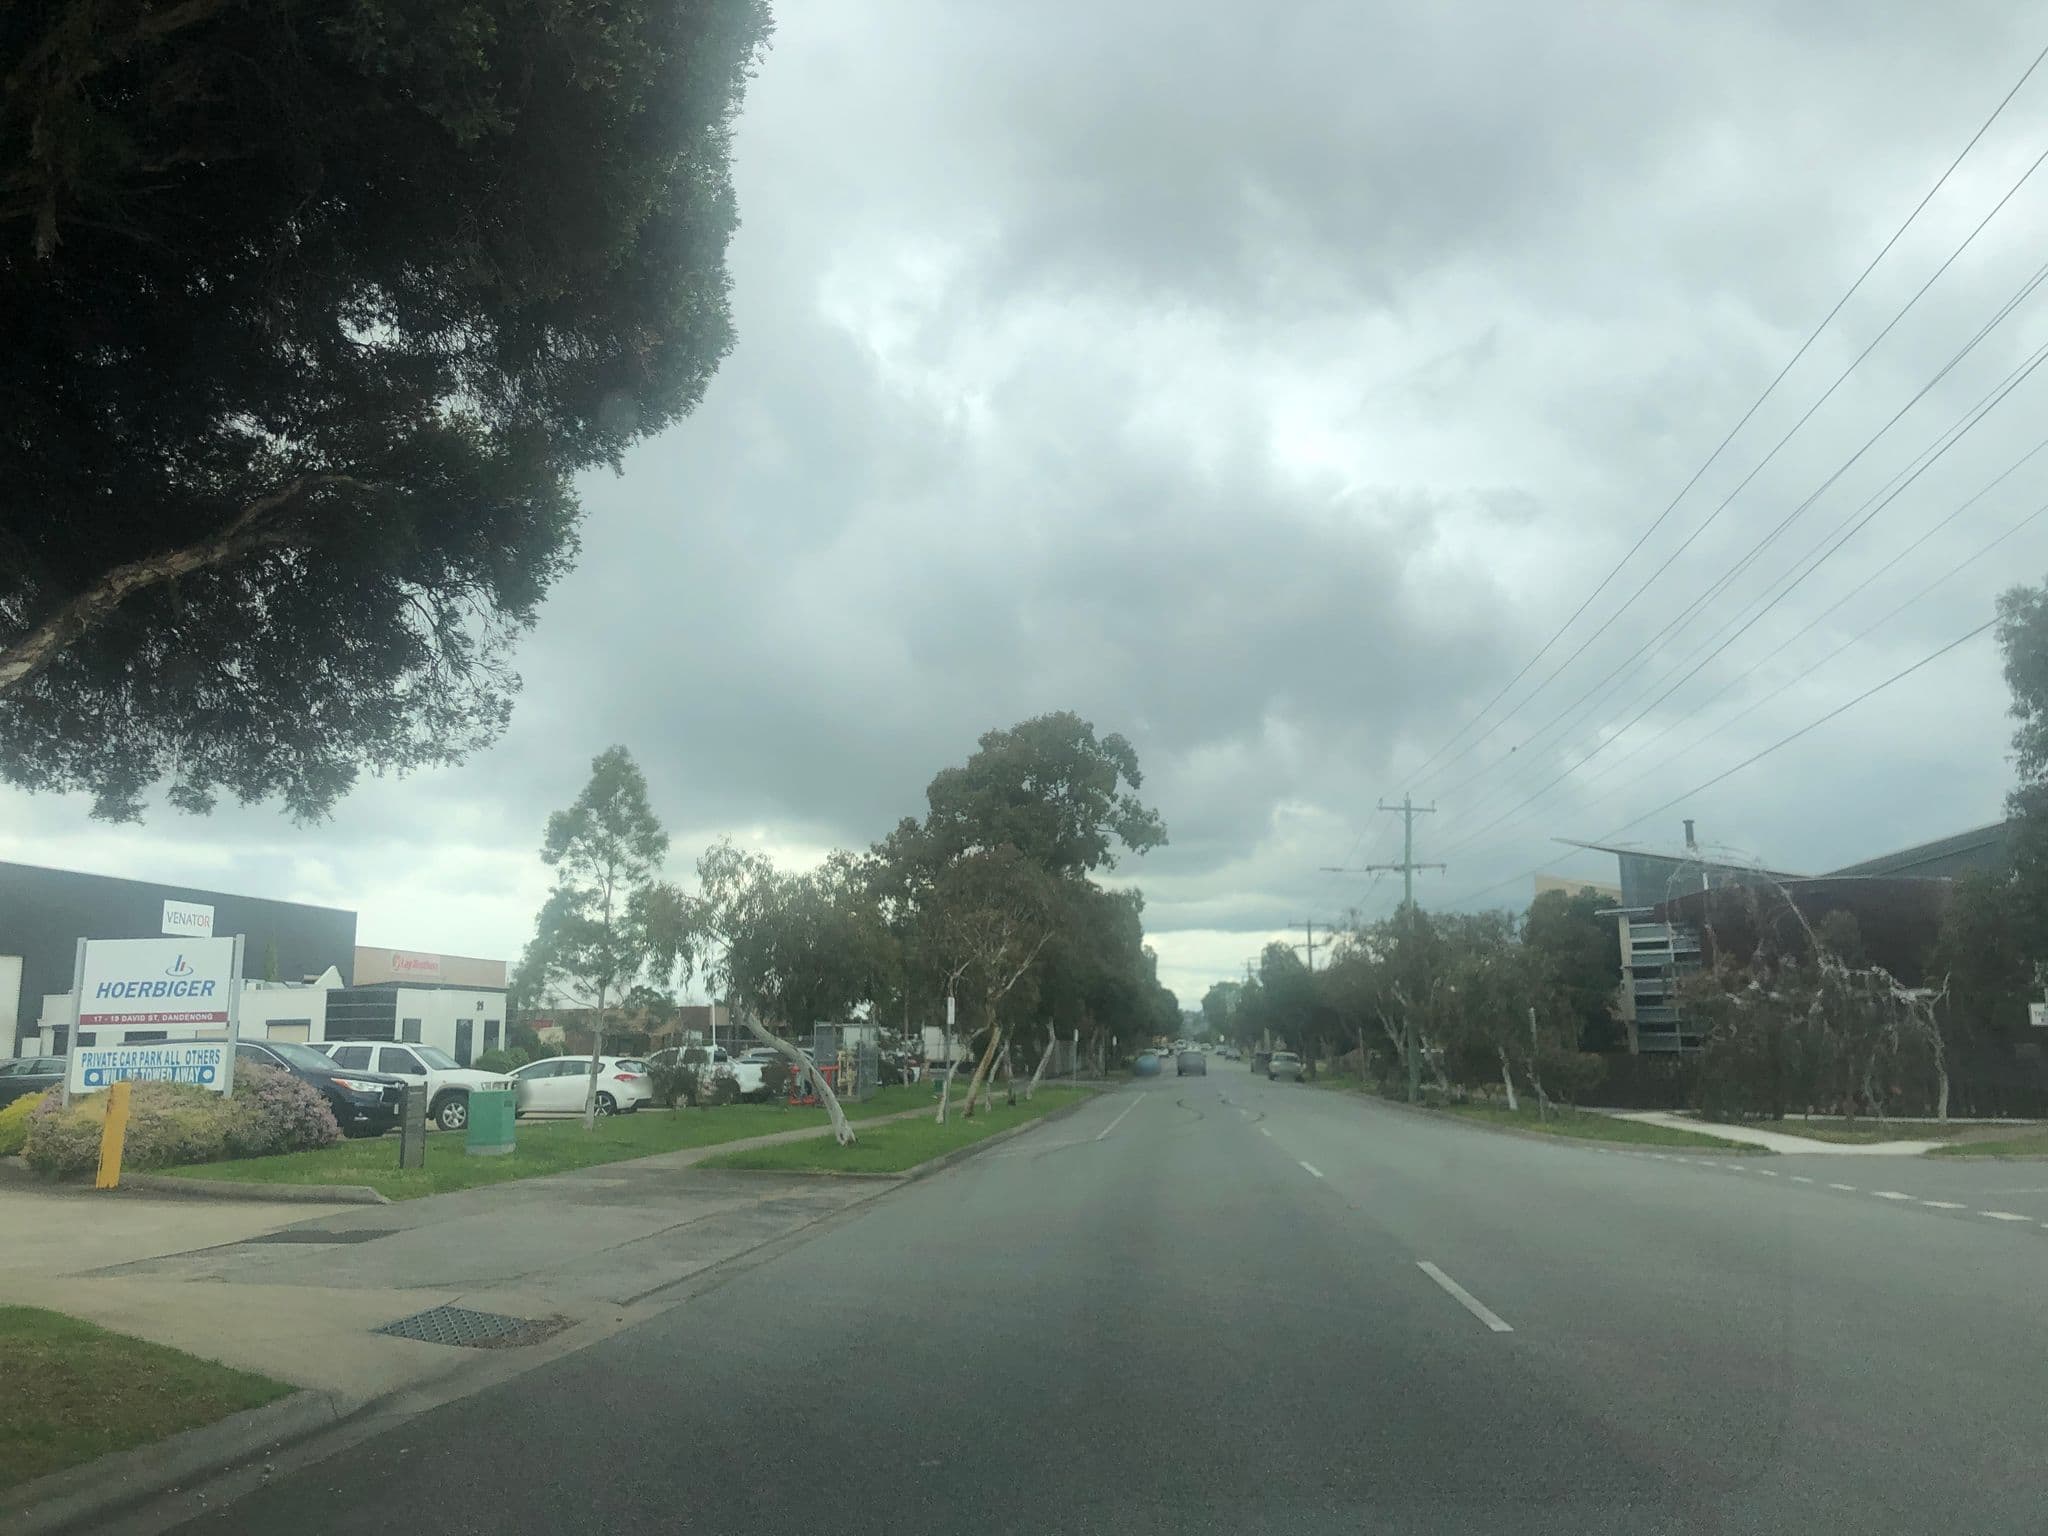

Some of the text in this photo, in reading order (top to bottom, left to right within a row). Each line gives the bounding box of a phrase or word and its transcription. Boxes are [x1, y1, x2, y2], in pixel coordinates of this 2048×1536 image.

[167, 912, 210, 927] VENATOR
[96, 980, 215, 998] HOERBIGER
[121, 1014, 145, 1022] DAVID
[162, 1013, 213, 1021] DANDENONG
[82, 1049, 220, 1067] PRIVATE CAR PARK ALL OTHERS
[140, 1066, 173, 1082] TOWED
[174, 1066, 201, 1083] AWAY
